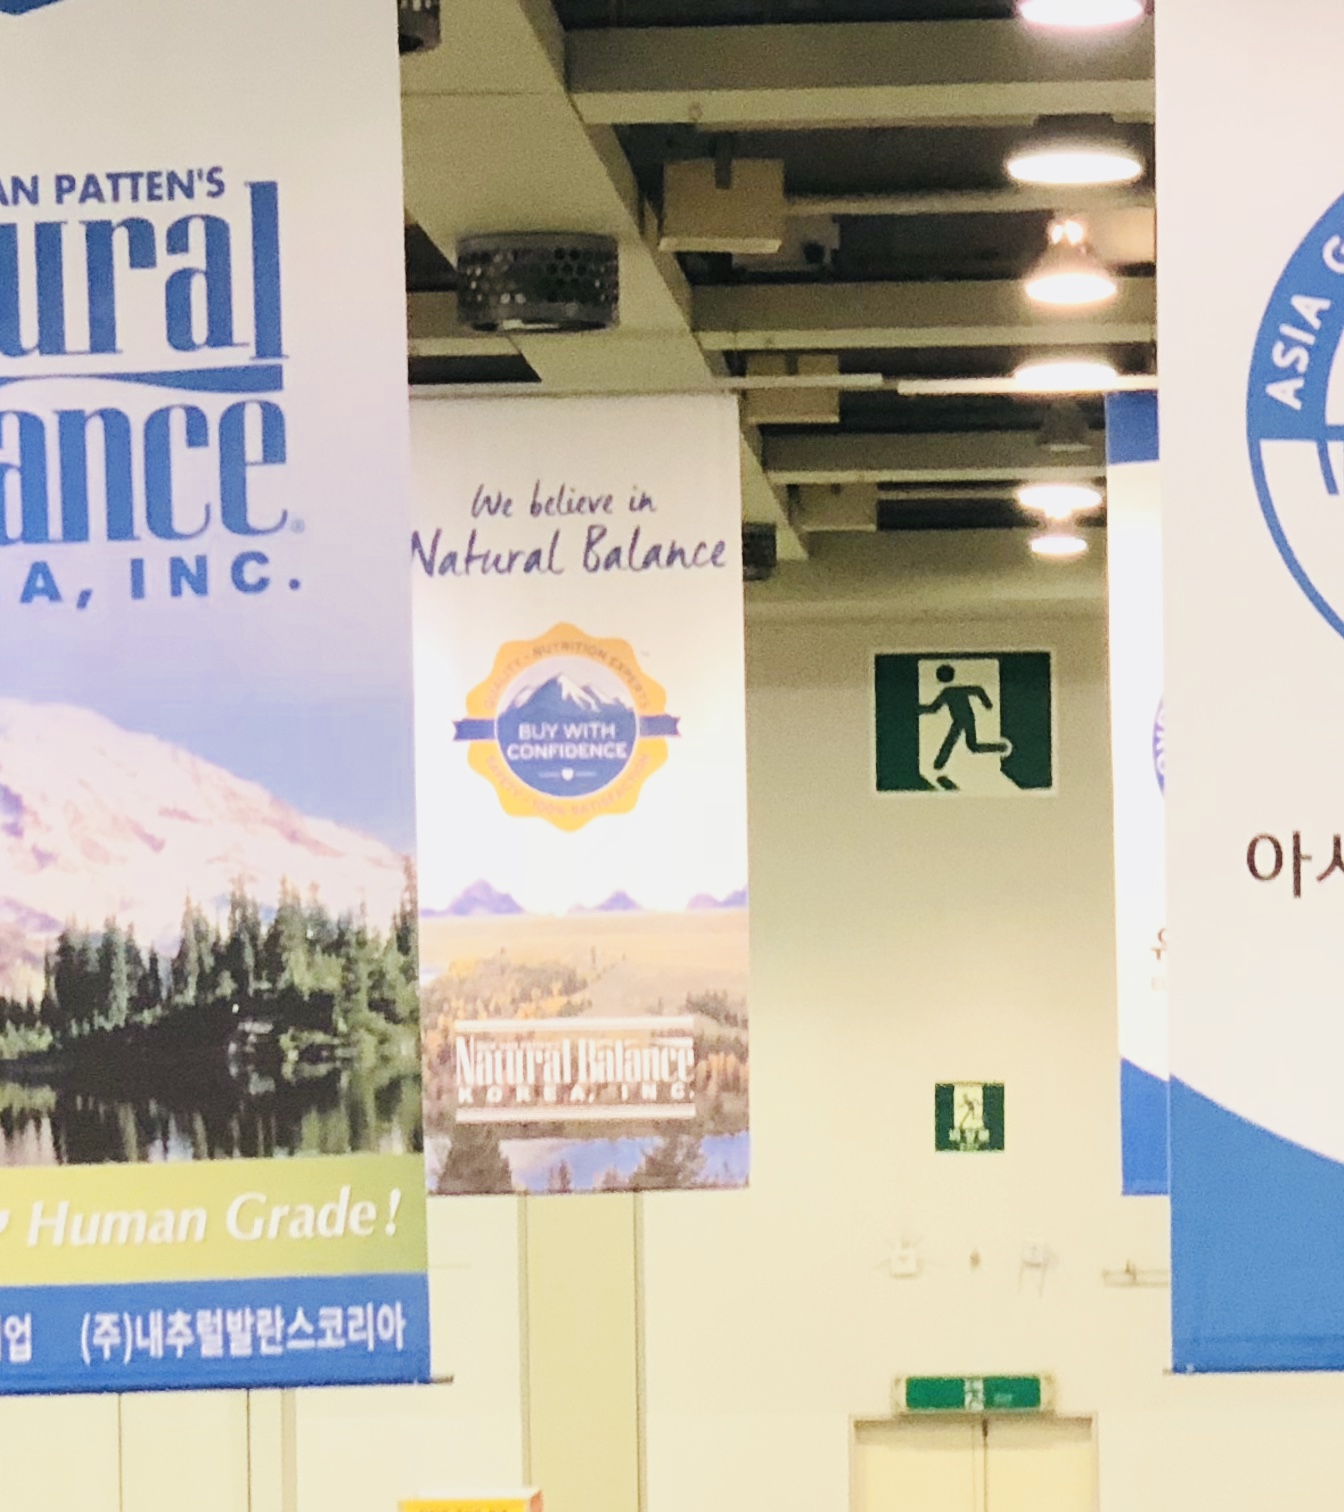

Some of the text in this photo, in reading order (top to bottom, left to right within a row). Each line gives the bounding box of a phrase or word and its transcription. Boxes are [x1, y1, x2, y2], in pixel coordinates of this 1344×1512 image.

[54, 166, 226, 205] PATTEN'S
[1265, 292, 1333, 412] ASIA
[470, 478, 658, 519] We believe in
[129, 551, 301, 601] INC.
[410, 524, 727, 578] Natural Balance
[506, 740, 628, 761] CONFIDENCE
[517, 721, 616, 741] BUY WITH
[456, 1034, 696, 1085] Natural Balance
[26, 1199, 208, 1247] Human
[224, 1187, 403, 1242] Grade!
